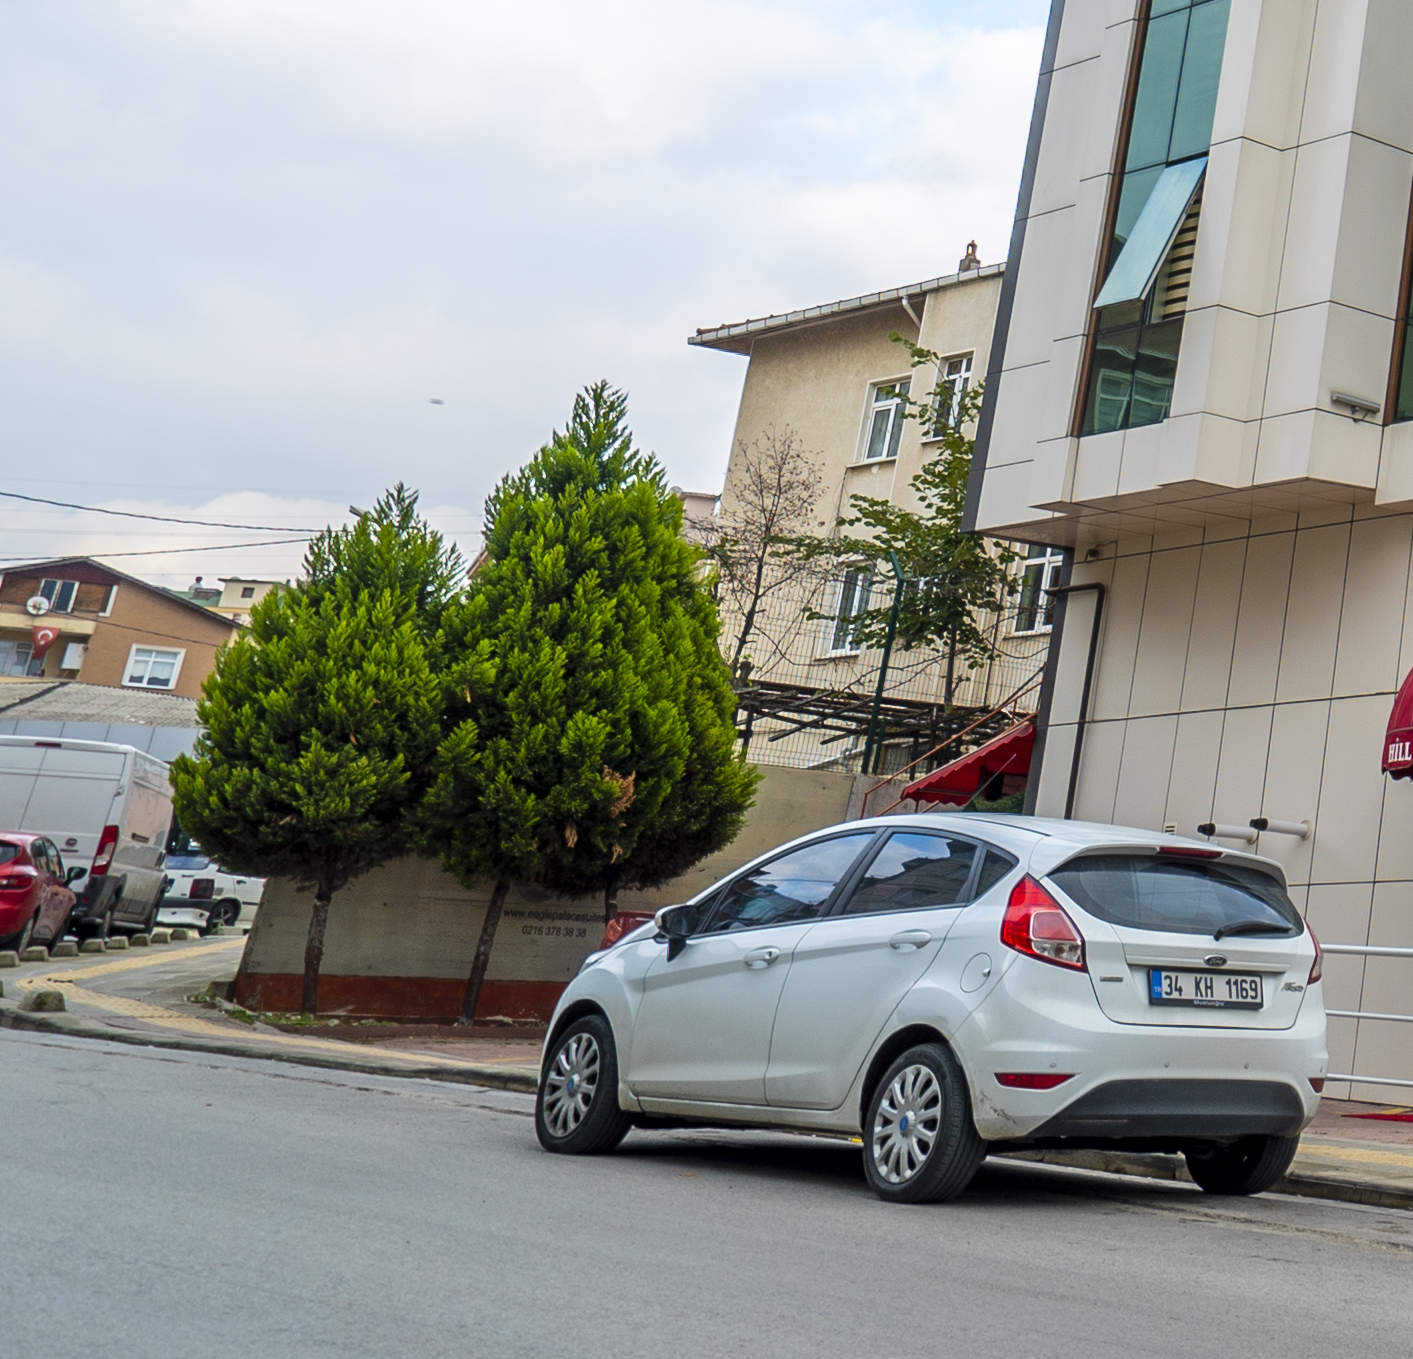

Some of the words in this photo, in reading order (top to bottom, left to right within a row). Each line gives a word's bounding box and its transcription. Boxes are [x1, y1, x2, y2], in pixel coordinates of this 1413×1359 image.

[1163, 975, 1183, 997] 34
[1194, 976, 1214, 998] KH
[1225, 977, 1259, 1000] 1169
